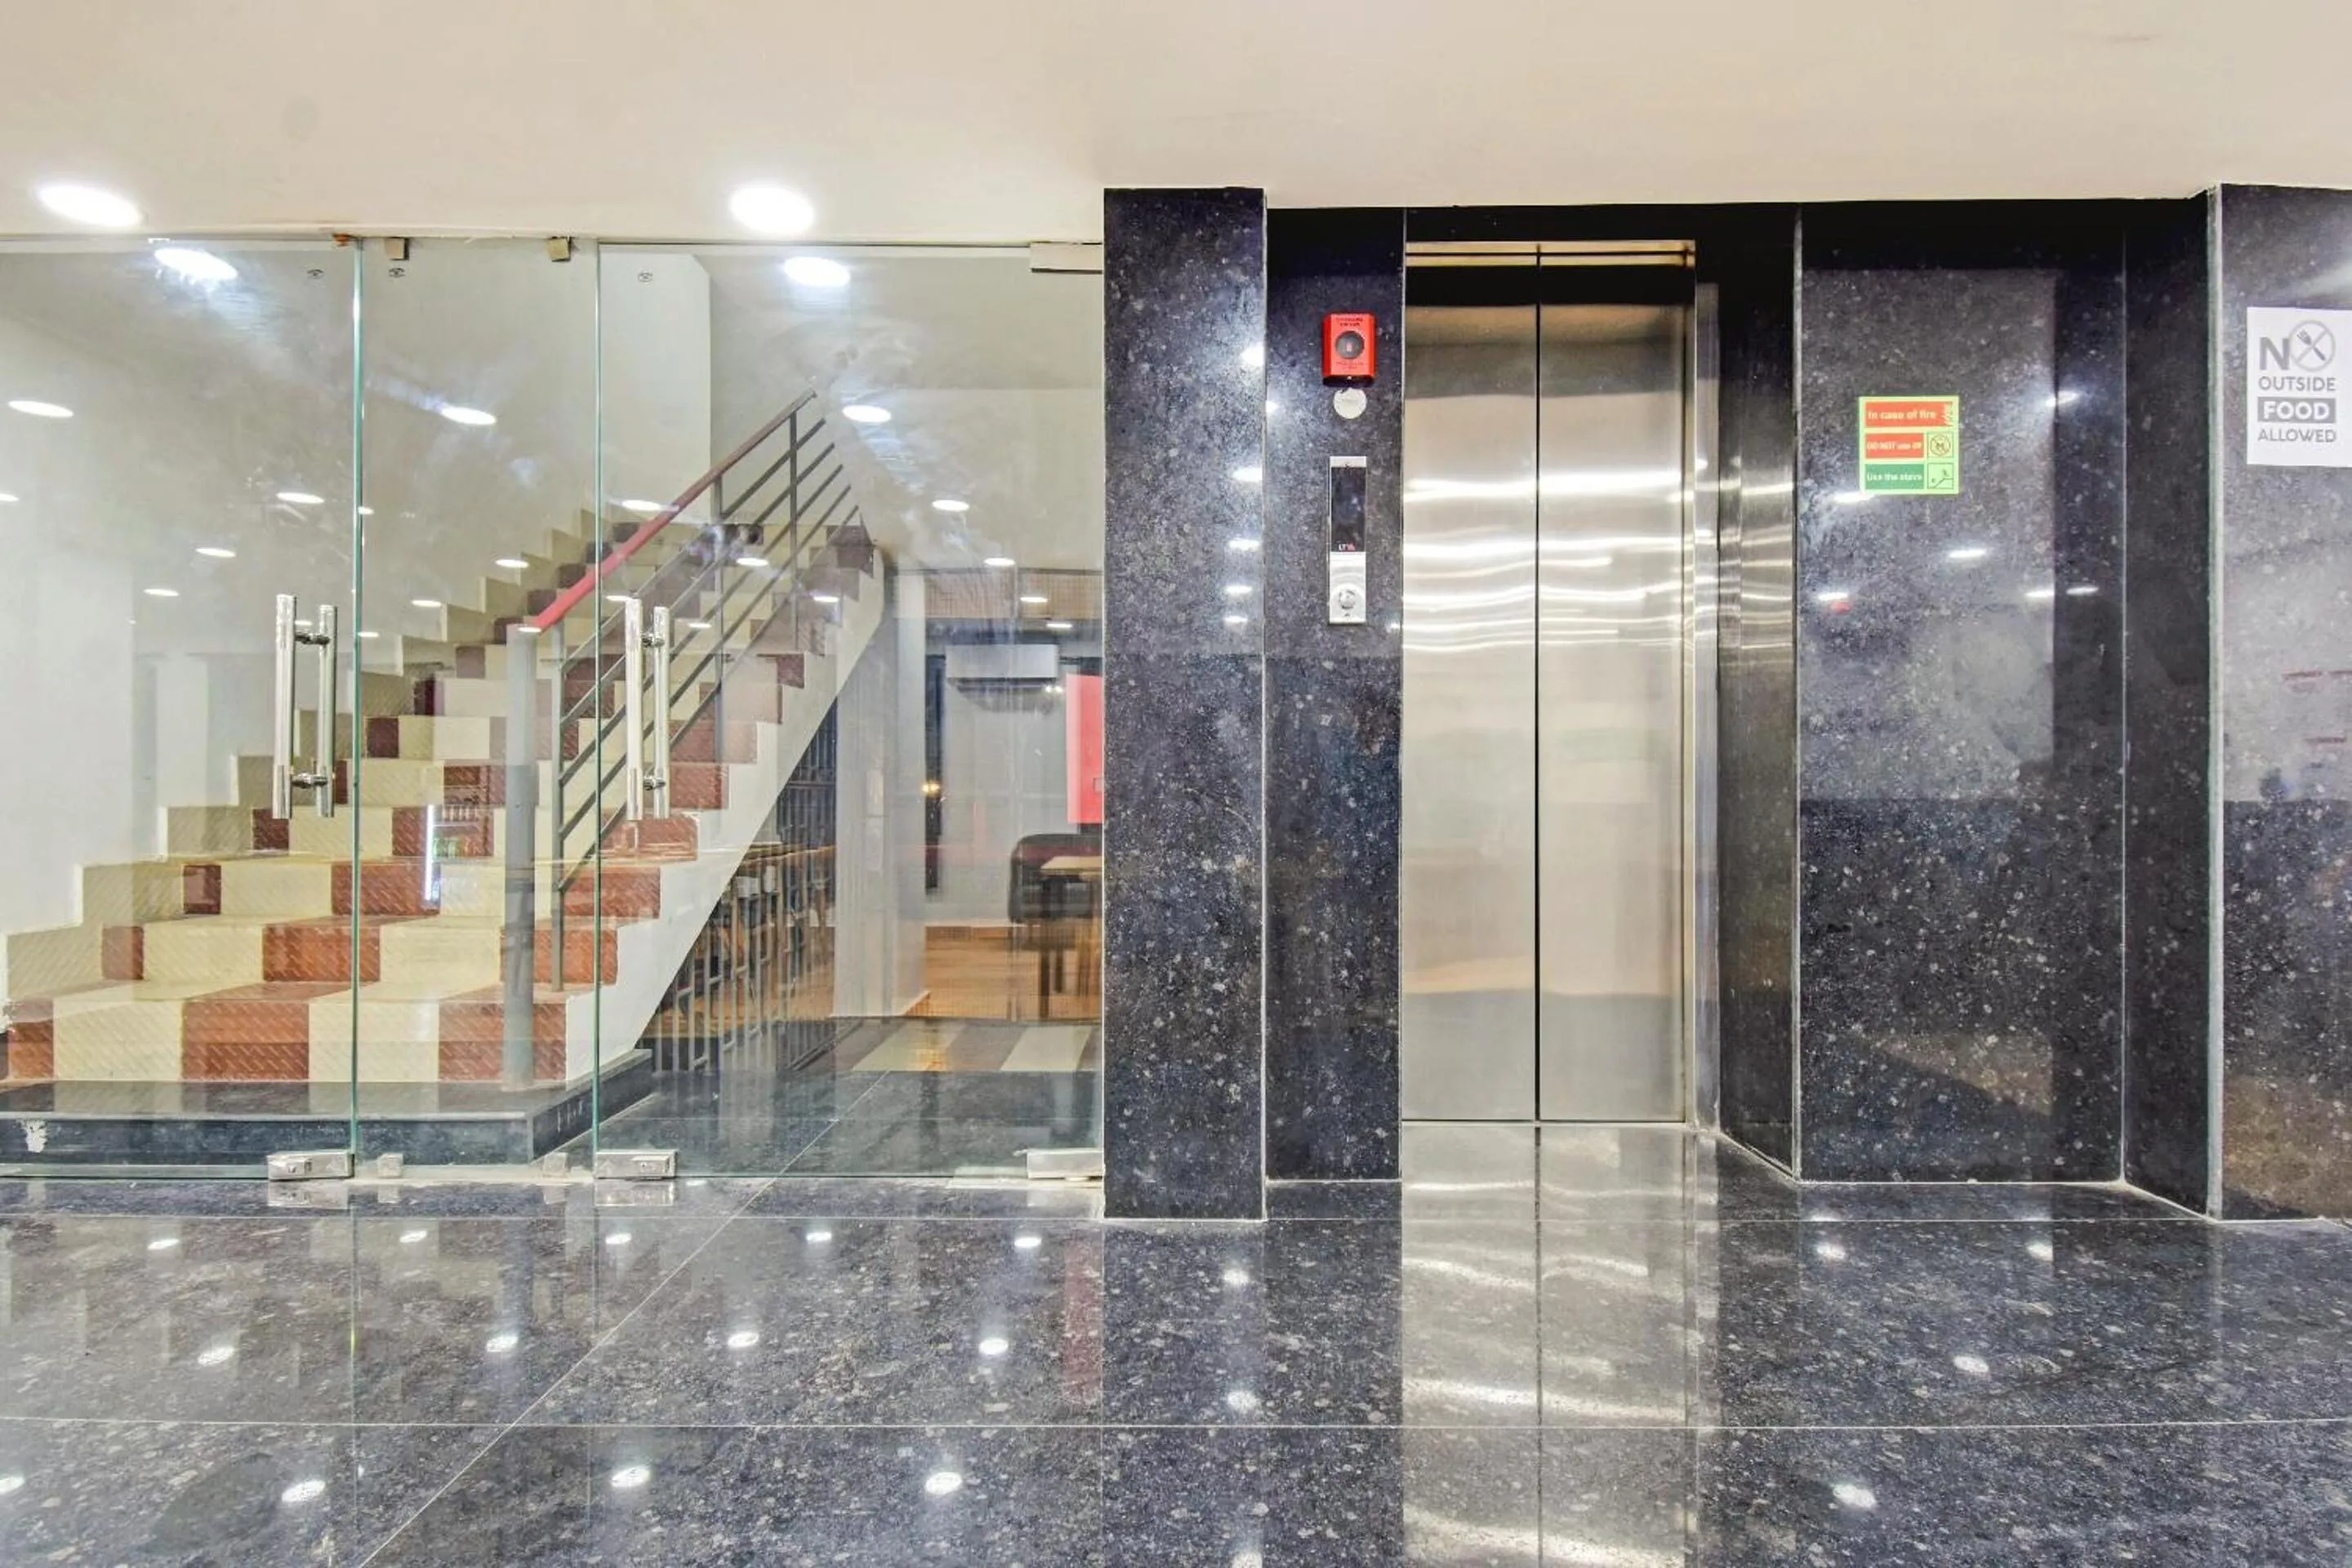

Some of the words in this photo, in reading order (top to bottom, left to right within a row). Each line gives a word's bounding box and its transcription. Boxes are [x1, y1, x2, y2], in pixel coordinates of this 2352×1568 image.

[2258, 376, 2336, 392] OUTSIDE
[1868, 411, 1878, 419] In
[1880, 412, 1904, 420] case
[1907, 410, 1918, 419] of
[1919, 410, 1937, 419] fire
[2263, 401, 2330, 421] FOOD
[2257, 428, 2336, 443] ALLOWED
[1881, 441, 1895, 450] NOT
[1867, 472, 1882, 481] Use
[1884, 471, 1899, 481] the
